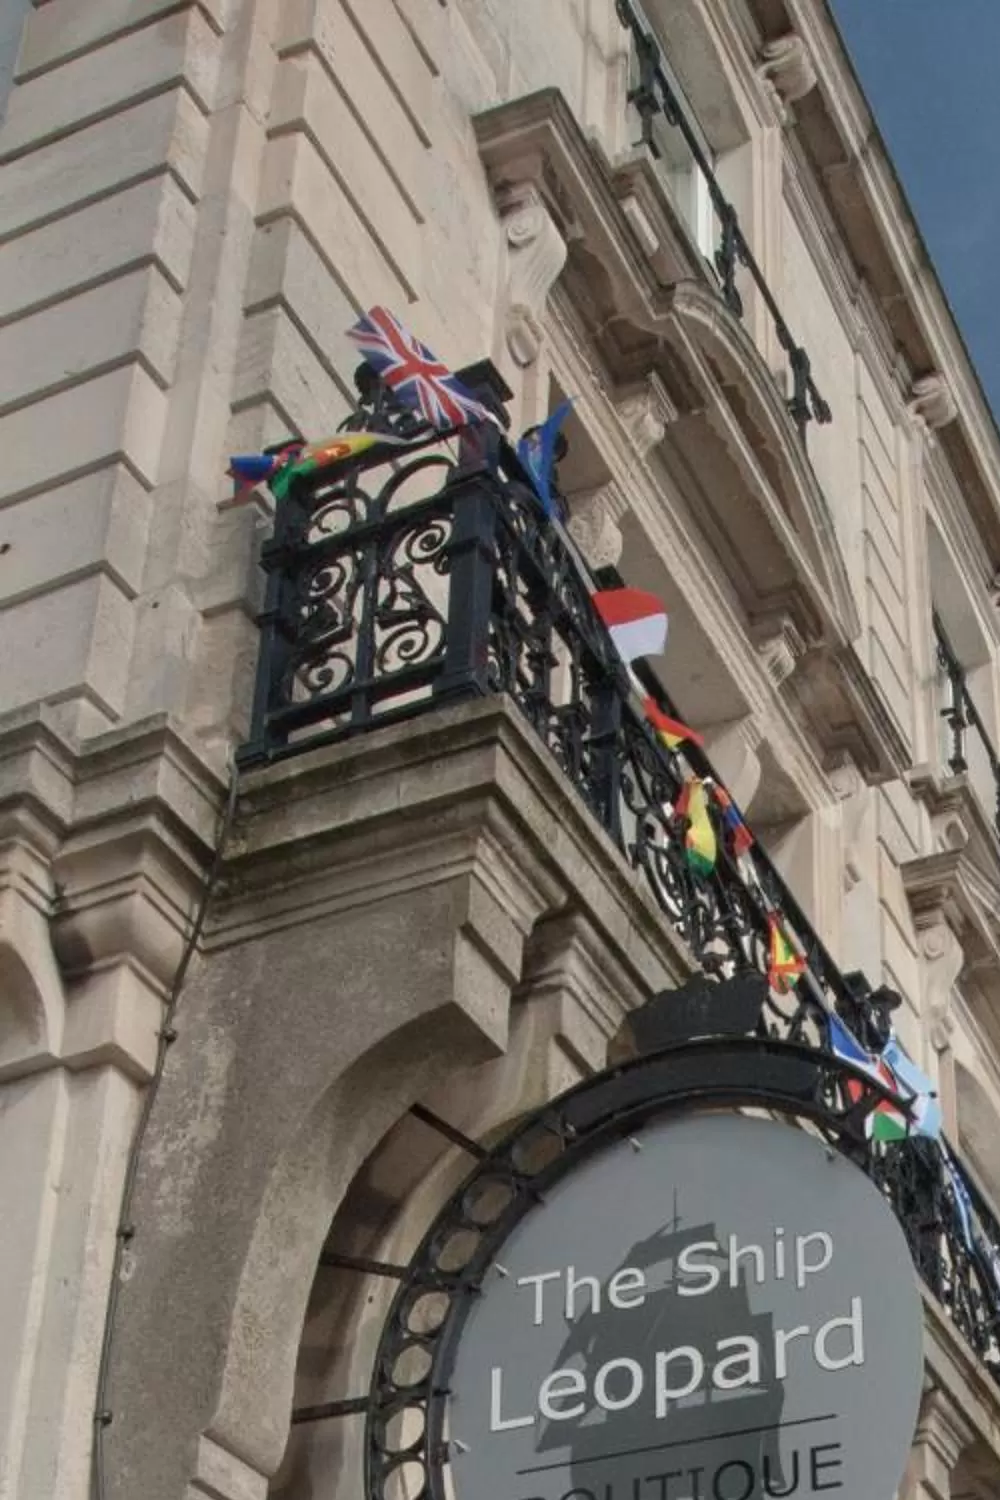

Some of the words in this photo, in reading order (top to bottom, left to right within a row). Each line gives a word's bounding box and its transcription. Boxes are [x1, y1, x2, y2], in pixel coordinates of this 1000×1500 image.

[518, 1263, 647, 1326] The
[675, 1227, 834, 1296] Ship
[489, 1296, 866, 1433] Leopard
